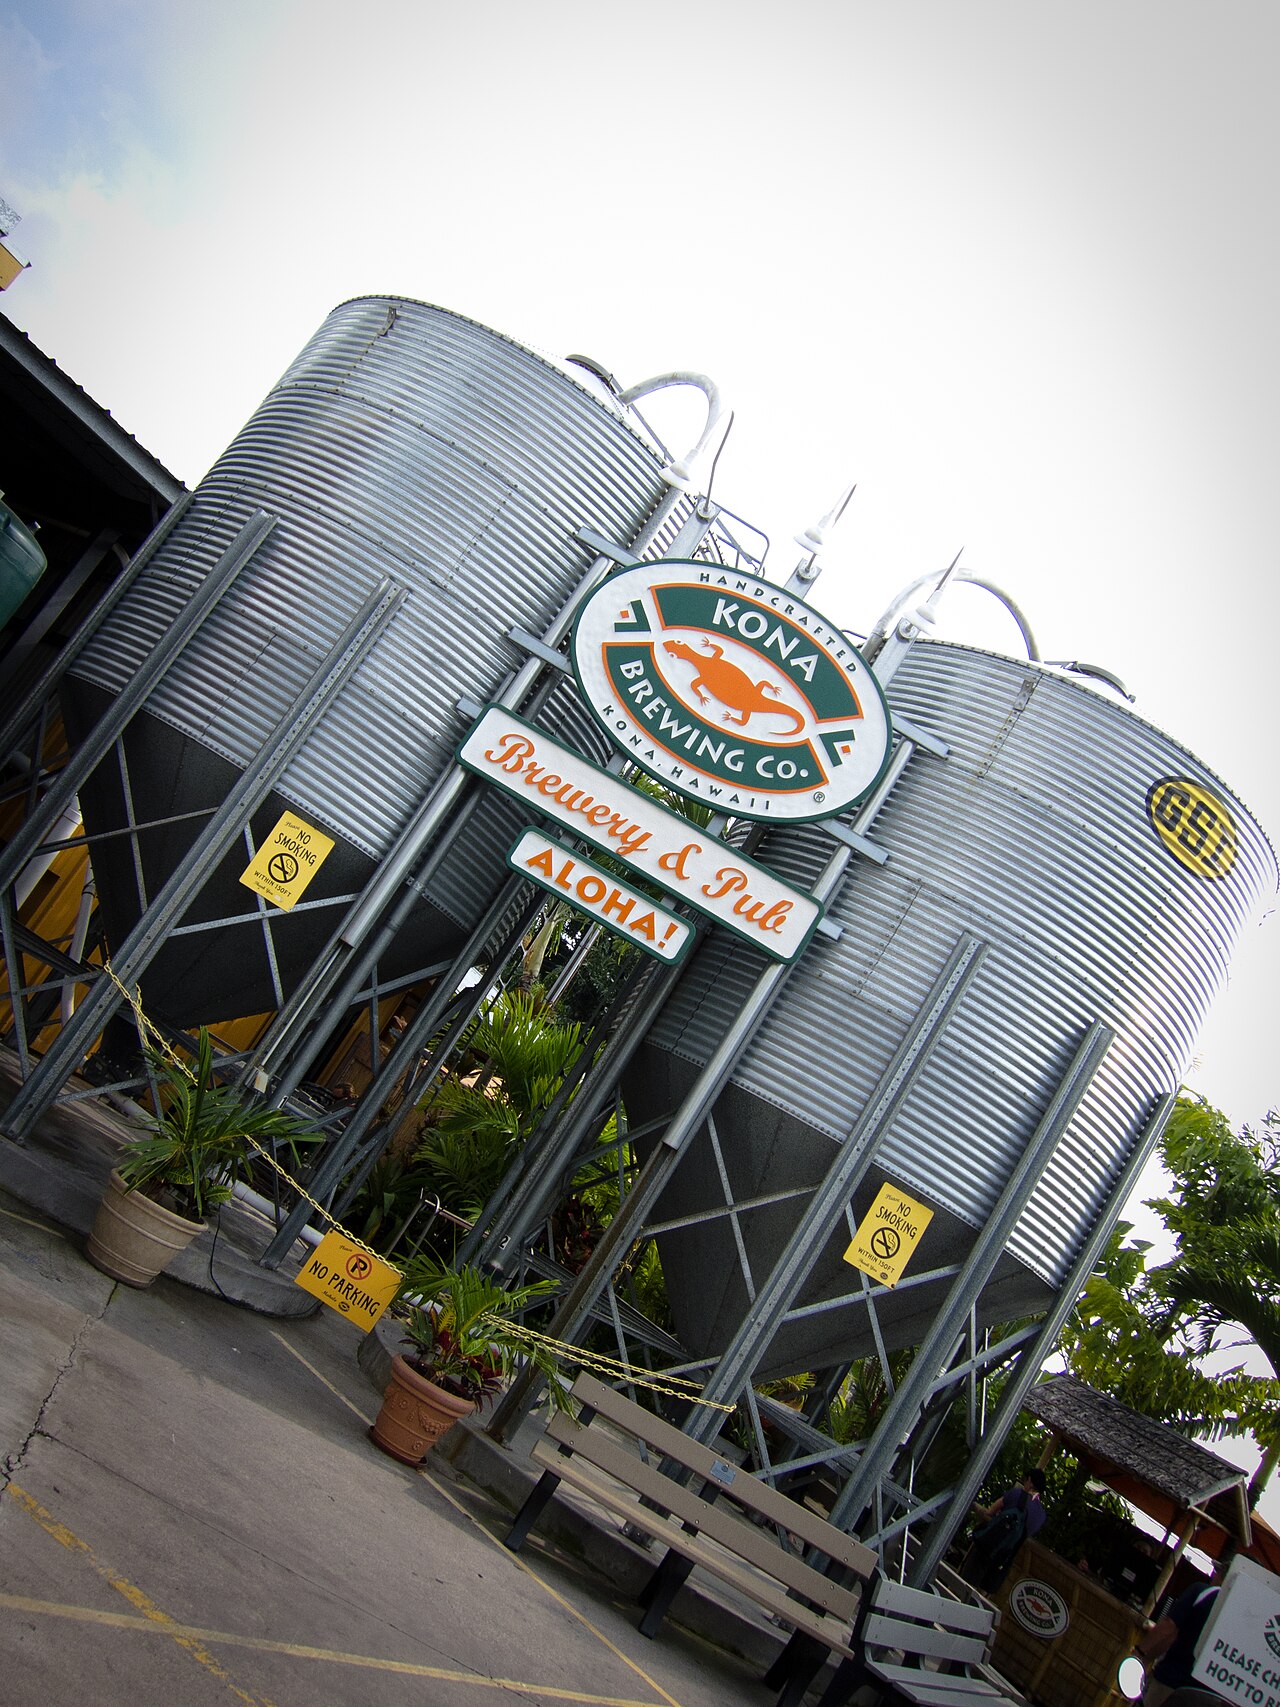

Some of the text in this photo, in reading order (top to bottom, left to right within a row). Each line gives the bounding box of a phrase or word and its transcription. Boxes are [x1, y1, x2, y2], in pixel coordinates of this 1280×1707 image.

[699, 572, 857, 673] HANDCRAFTED
[712, 597, 820, 682] KONA
[619, 659, 745, 773] BREWING
[670, 765, 771, 811] HAWAII
[274, 832, 317, 867] SMOKING
[295, 830, 311, 845] NO
[484, 733, 795, 934] Brewery & Pub
[254, 870, 275, 887] WITHIN
[525, 847, 680, 949] ALOHA!
[875, 1205, 918, 1240] SMOKING
[896, 1202, 912, 1217] NO
[857, 1247, 878, 1264] WITHIN
[308, 1259, 381, 1317] NO PARKING
[1213, 1638, 1262, 1677] PLEASE
[1205, 1660, 1244, 1692] HOST
[1243, 1683, 1264, 1704] TO
